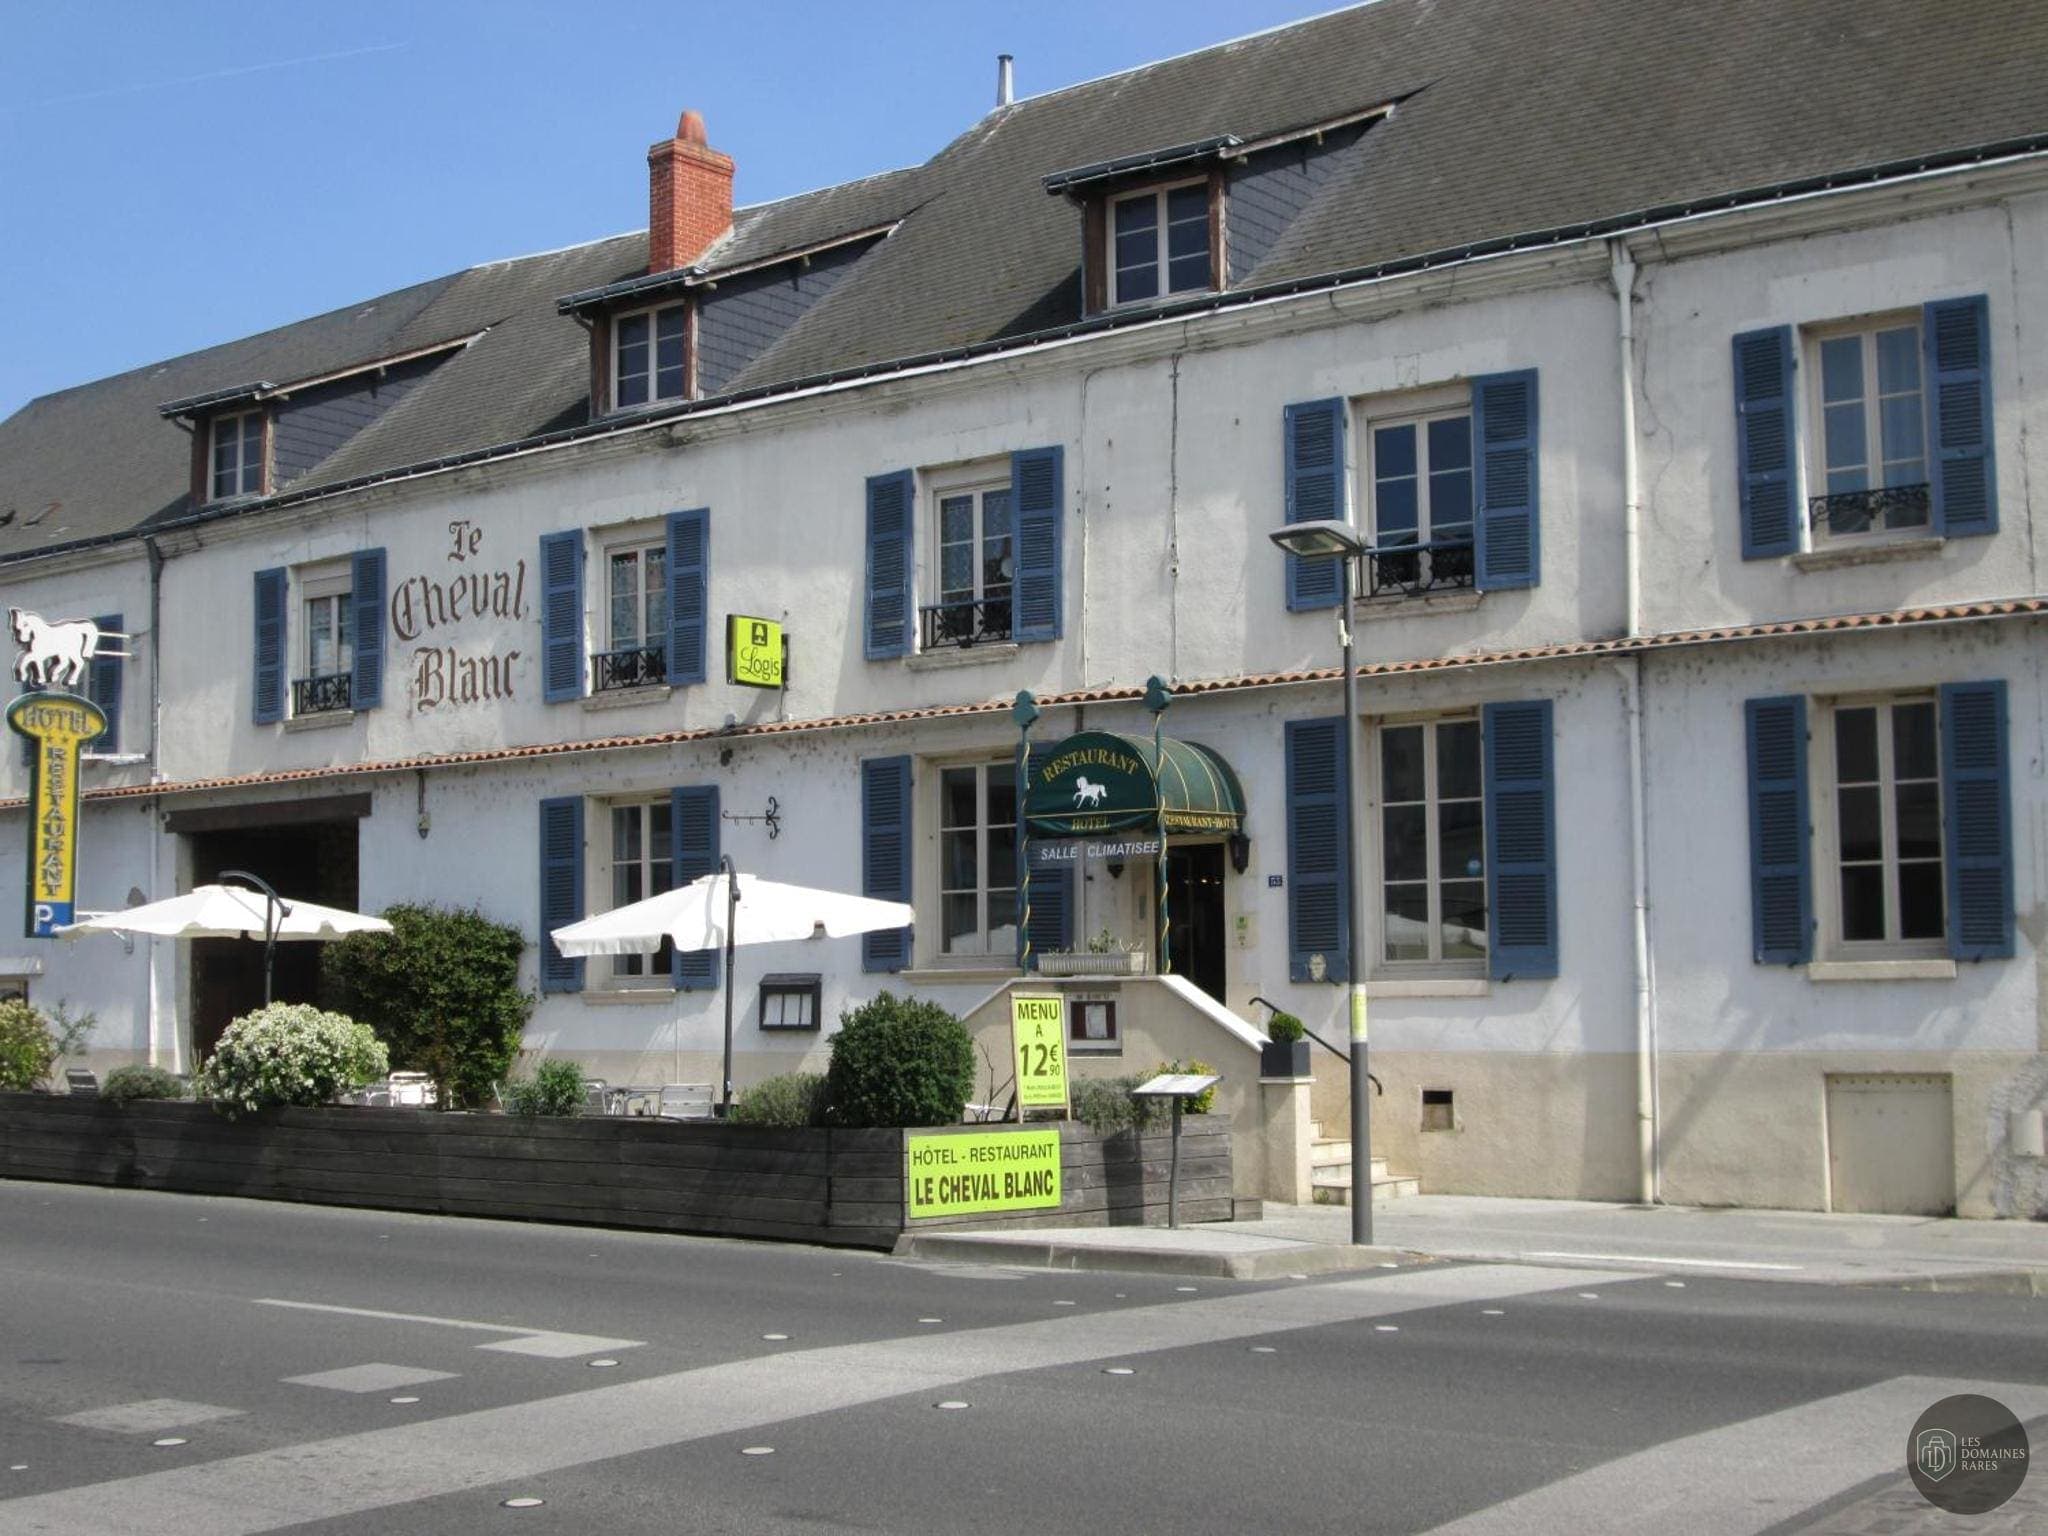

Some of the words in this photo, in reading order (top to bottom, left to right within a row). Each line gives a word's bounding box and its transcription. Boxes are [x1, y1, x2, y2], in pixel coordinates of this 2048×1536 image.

[448, 520, 482, 562] Le
[391, 558, 525, 641] Cheval
[413, 646, 521, 712] Blanc
[739, 646, 780, 681] Logis
[1041, 749, 1139, 782] RESTAURANT
[41, 746, 66, 896] RESTAURANT
[1071, 816, 1111, 831] HOTEL
[1041, 846, 1078, 861] SALLE
[1087, 841, 1159, 858] CLIMATISEE
[1018, 1003, 1058, 1020] MENU
[913, 1145, 958, 1166] HÔTEL
[970, 1143, 1054, 1163] RESTAURANT
[915, 1177, 934, 1206] LE
[939, 1173, 1000, 1204] CHEVAL
[1004, 1169, 1054, 1199] BLANC
